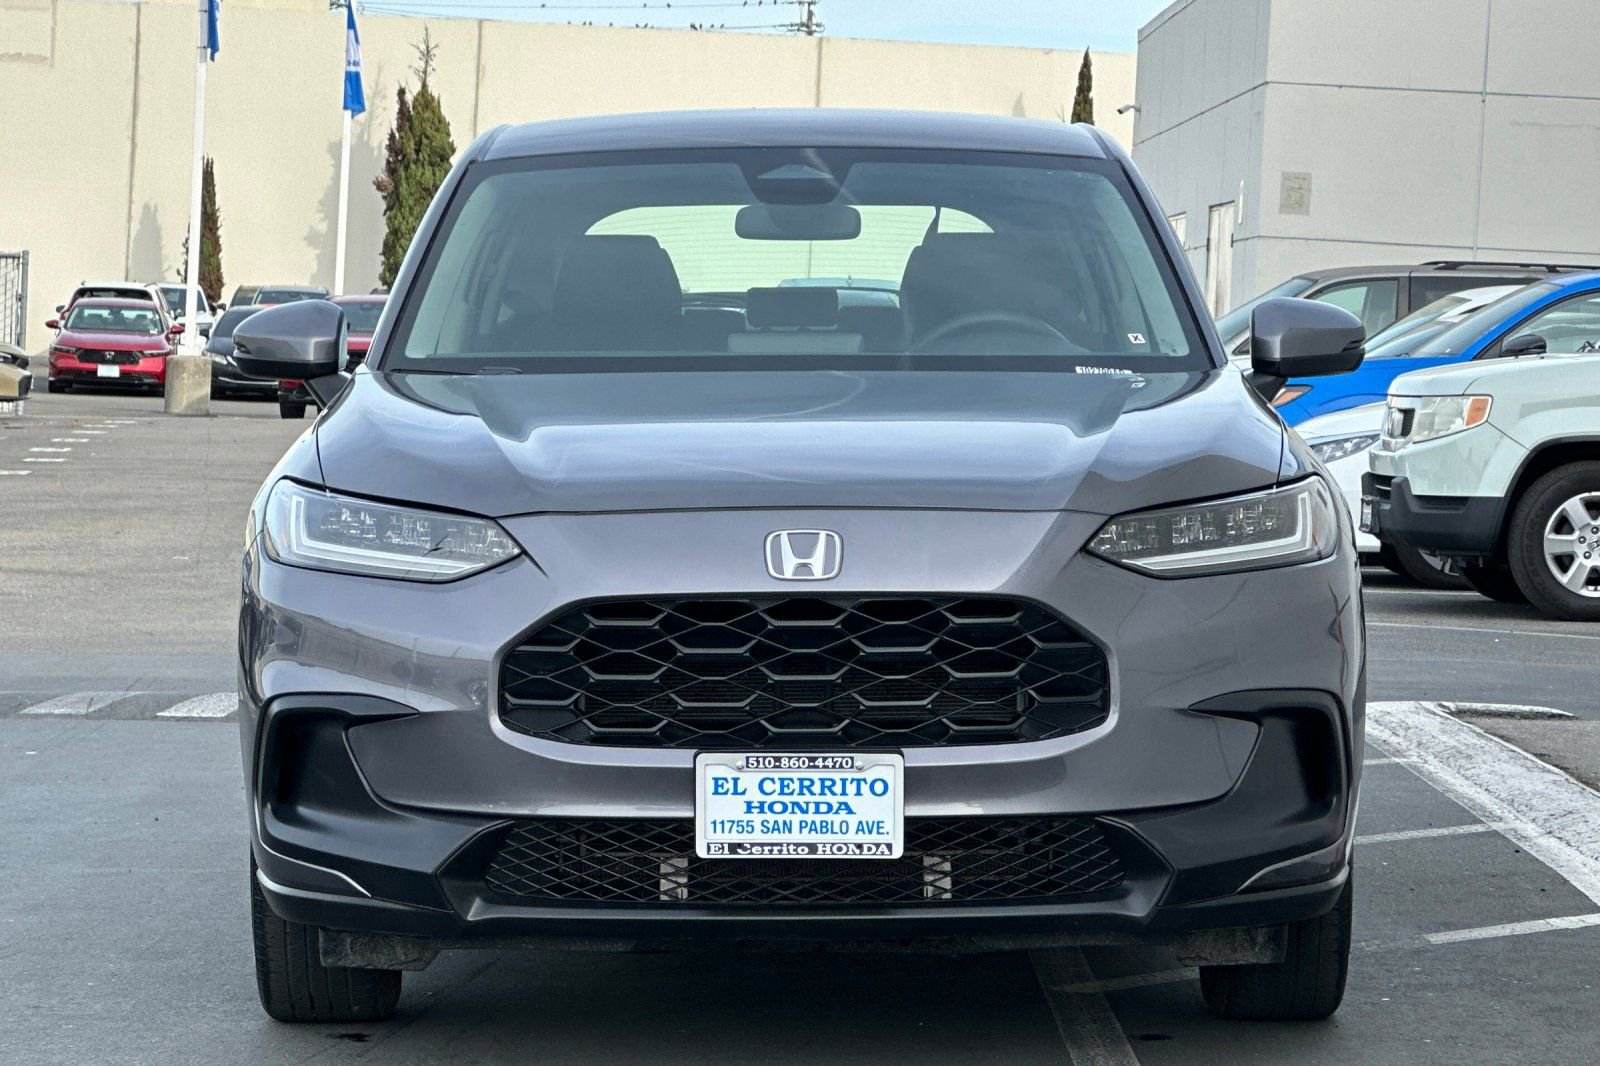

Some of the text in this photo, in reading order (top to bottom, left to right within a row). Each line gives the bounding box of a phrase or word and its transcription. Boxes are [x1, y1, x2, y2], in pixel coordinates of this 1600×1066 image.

[748, 757, 852, 769] 510-860-4470
[711, 777, 889, 797] EL CERRITO
[744, 801, 856, 815] HONDA
[710, 820, 890, 835] 11755 SAN PABLO AVE.
[709, 843, 729, 855] El
[816, 843, 891, 855] HONDA
